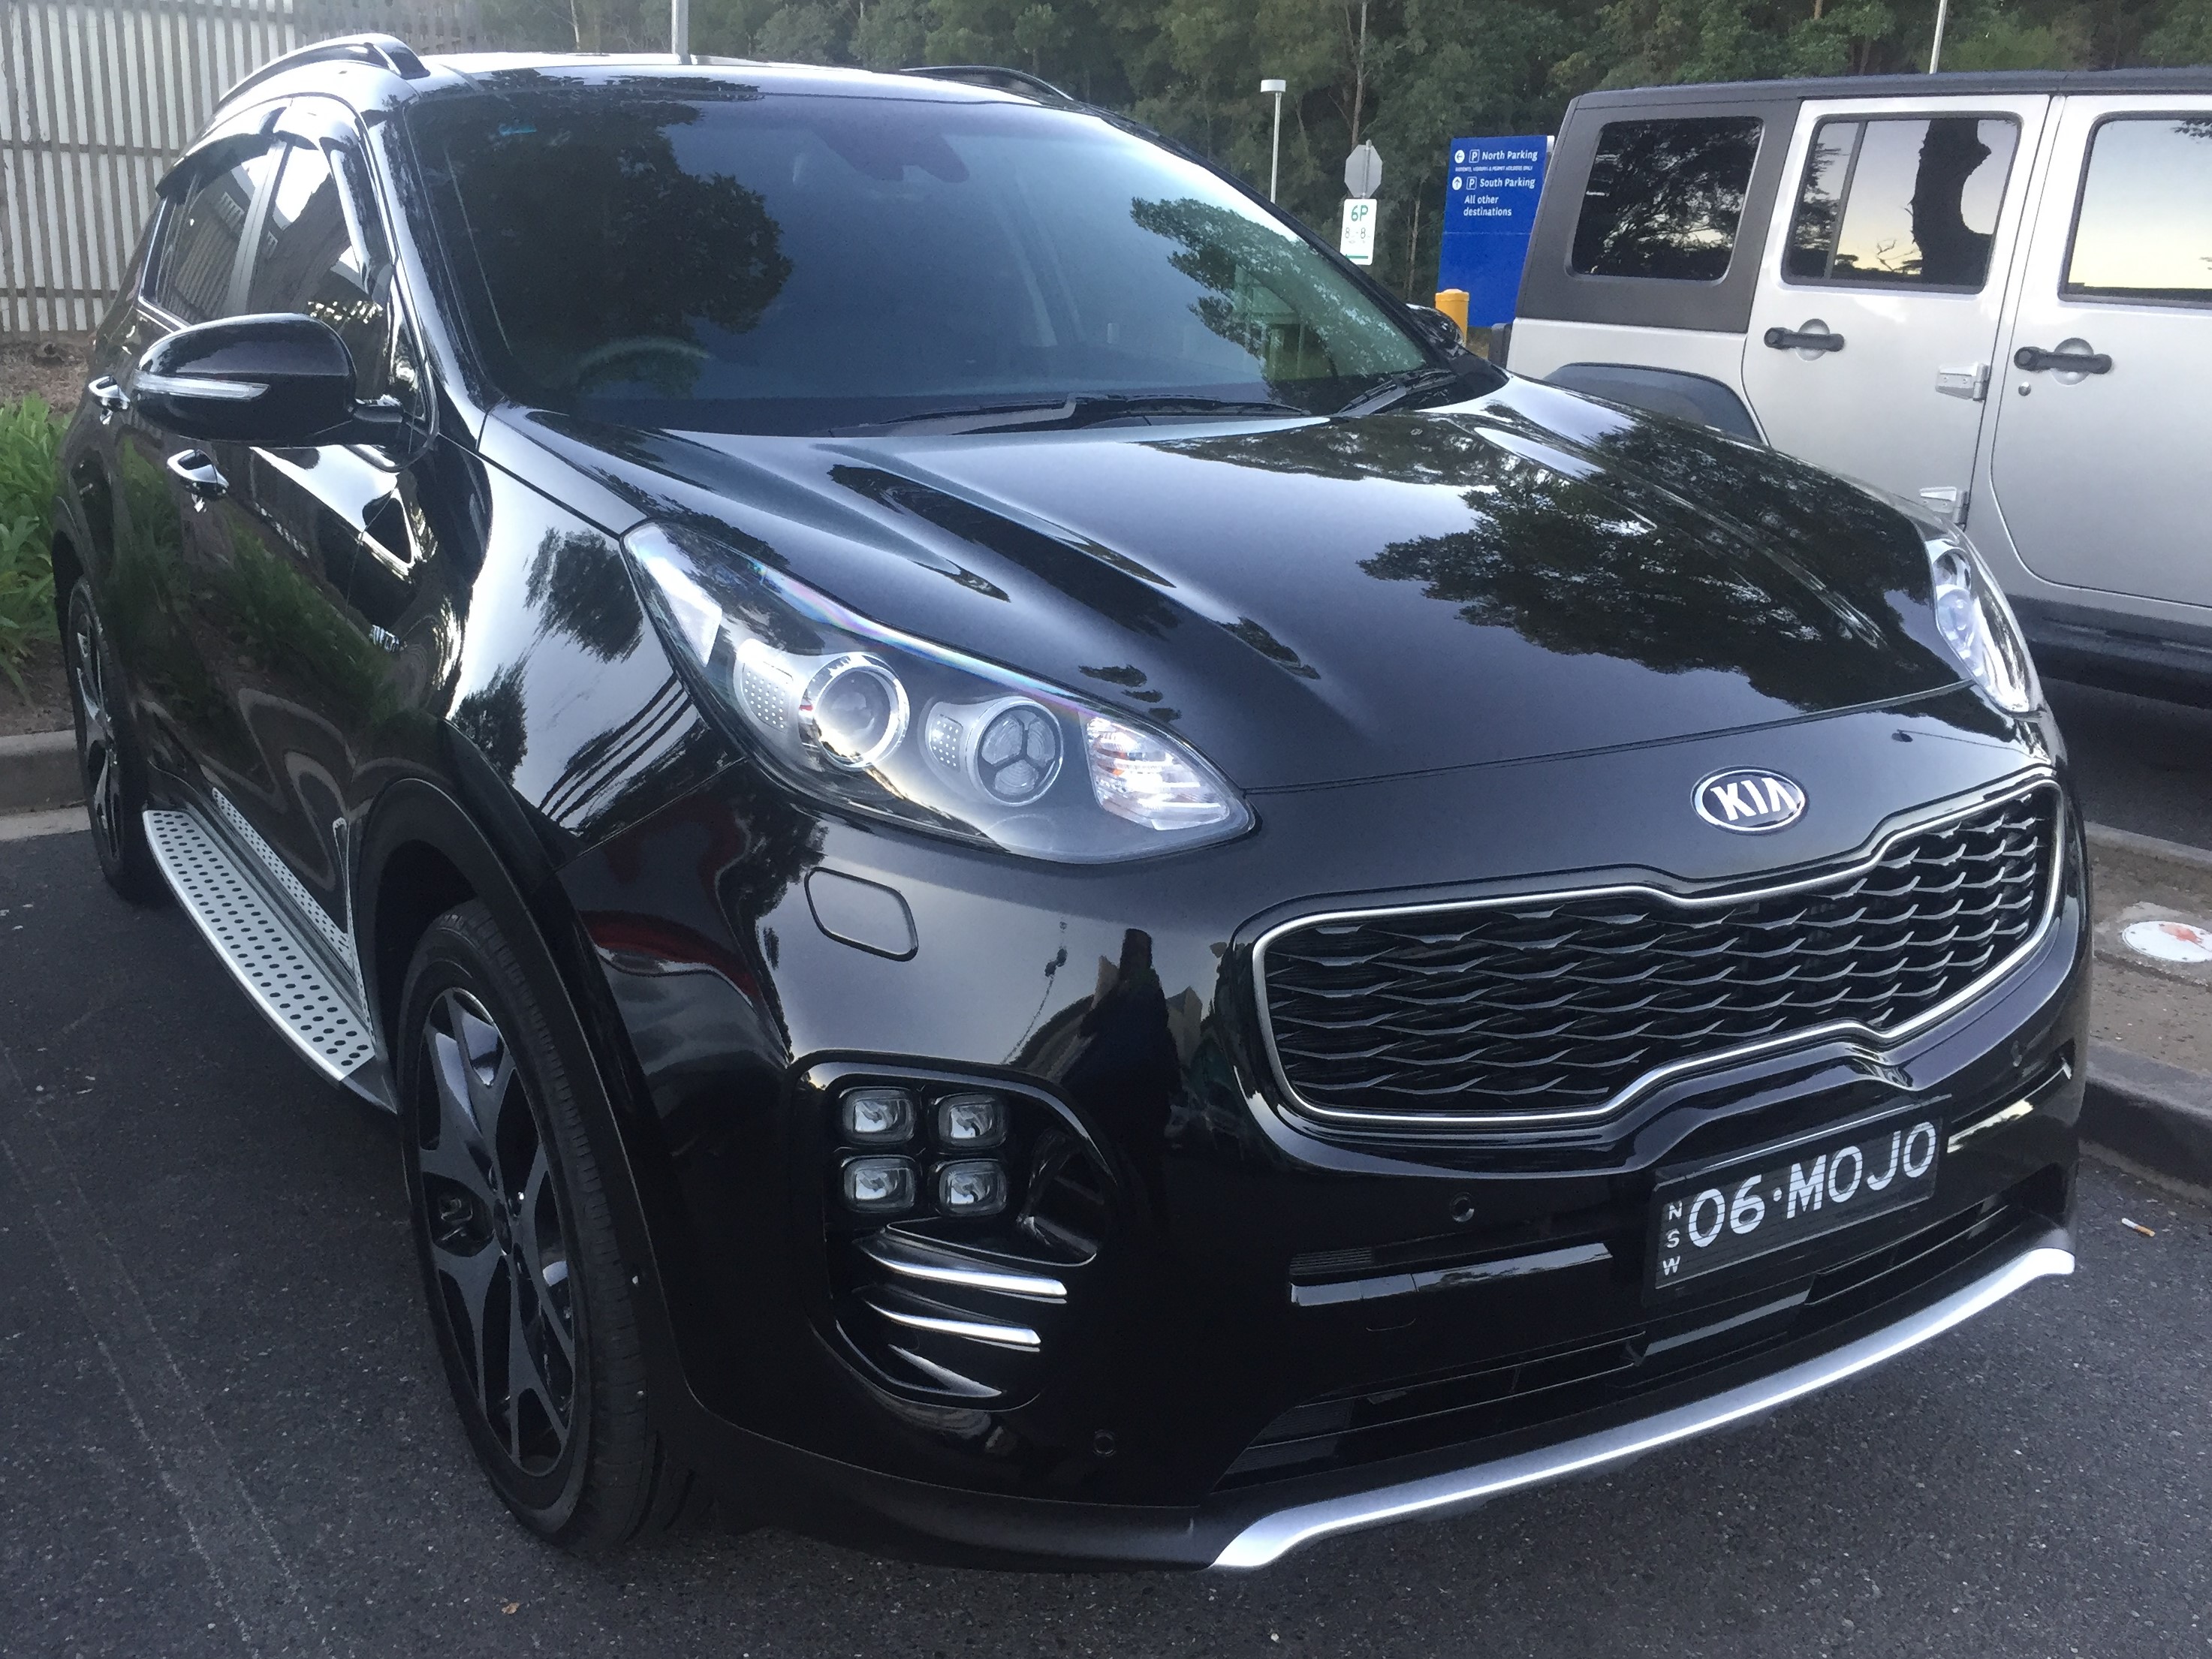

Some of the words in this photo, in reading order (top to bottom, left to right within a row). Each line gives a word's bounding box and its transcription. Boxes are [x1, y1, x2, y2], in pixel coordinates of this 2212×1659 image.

[1481, 150, 1505, 160] North
[1507, 149, 1538, 161] Parking
[1479, 178, 1502, 188] South
[1504, 177, 1535, 189] Parking
[1464, 195, 1475, 204] All
[1477, 195, 1499, 204] other
[1351, 205, 1369, 221] 6P
[1463, 206, 1512, 216] destinations
[1361, 227, 1366, 239] 8
[1710, 777, 1797, 821] KIA
